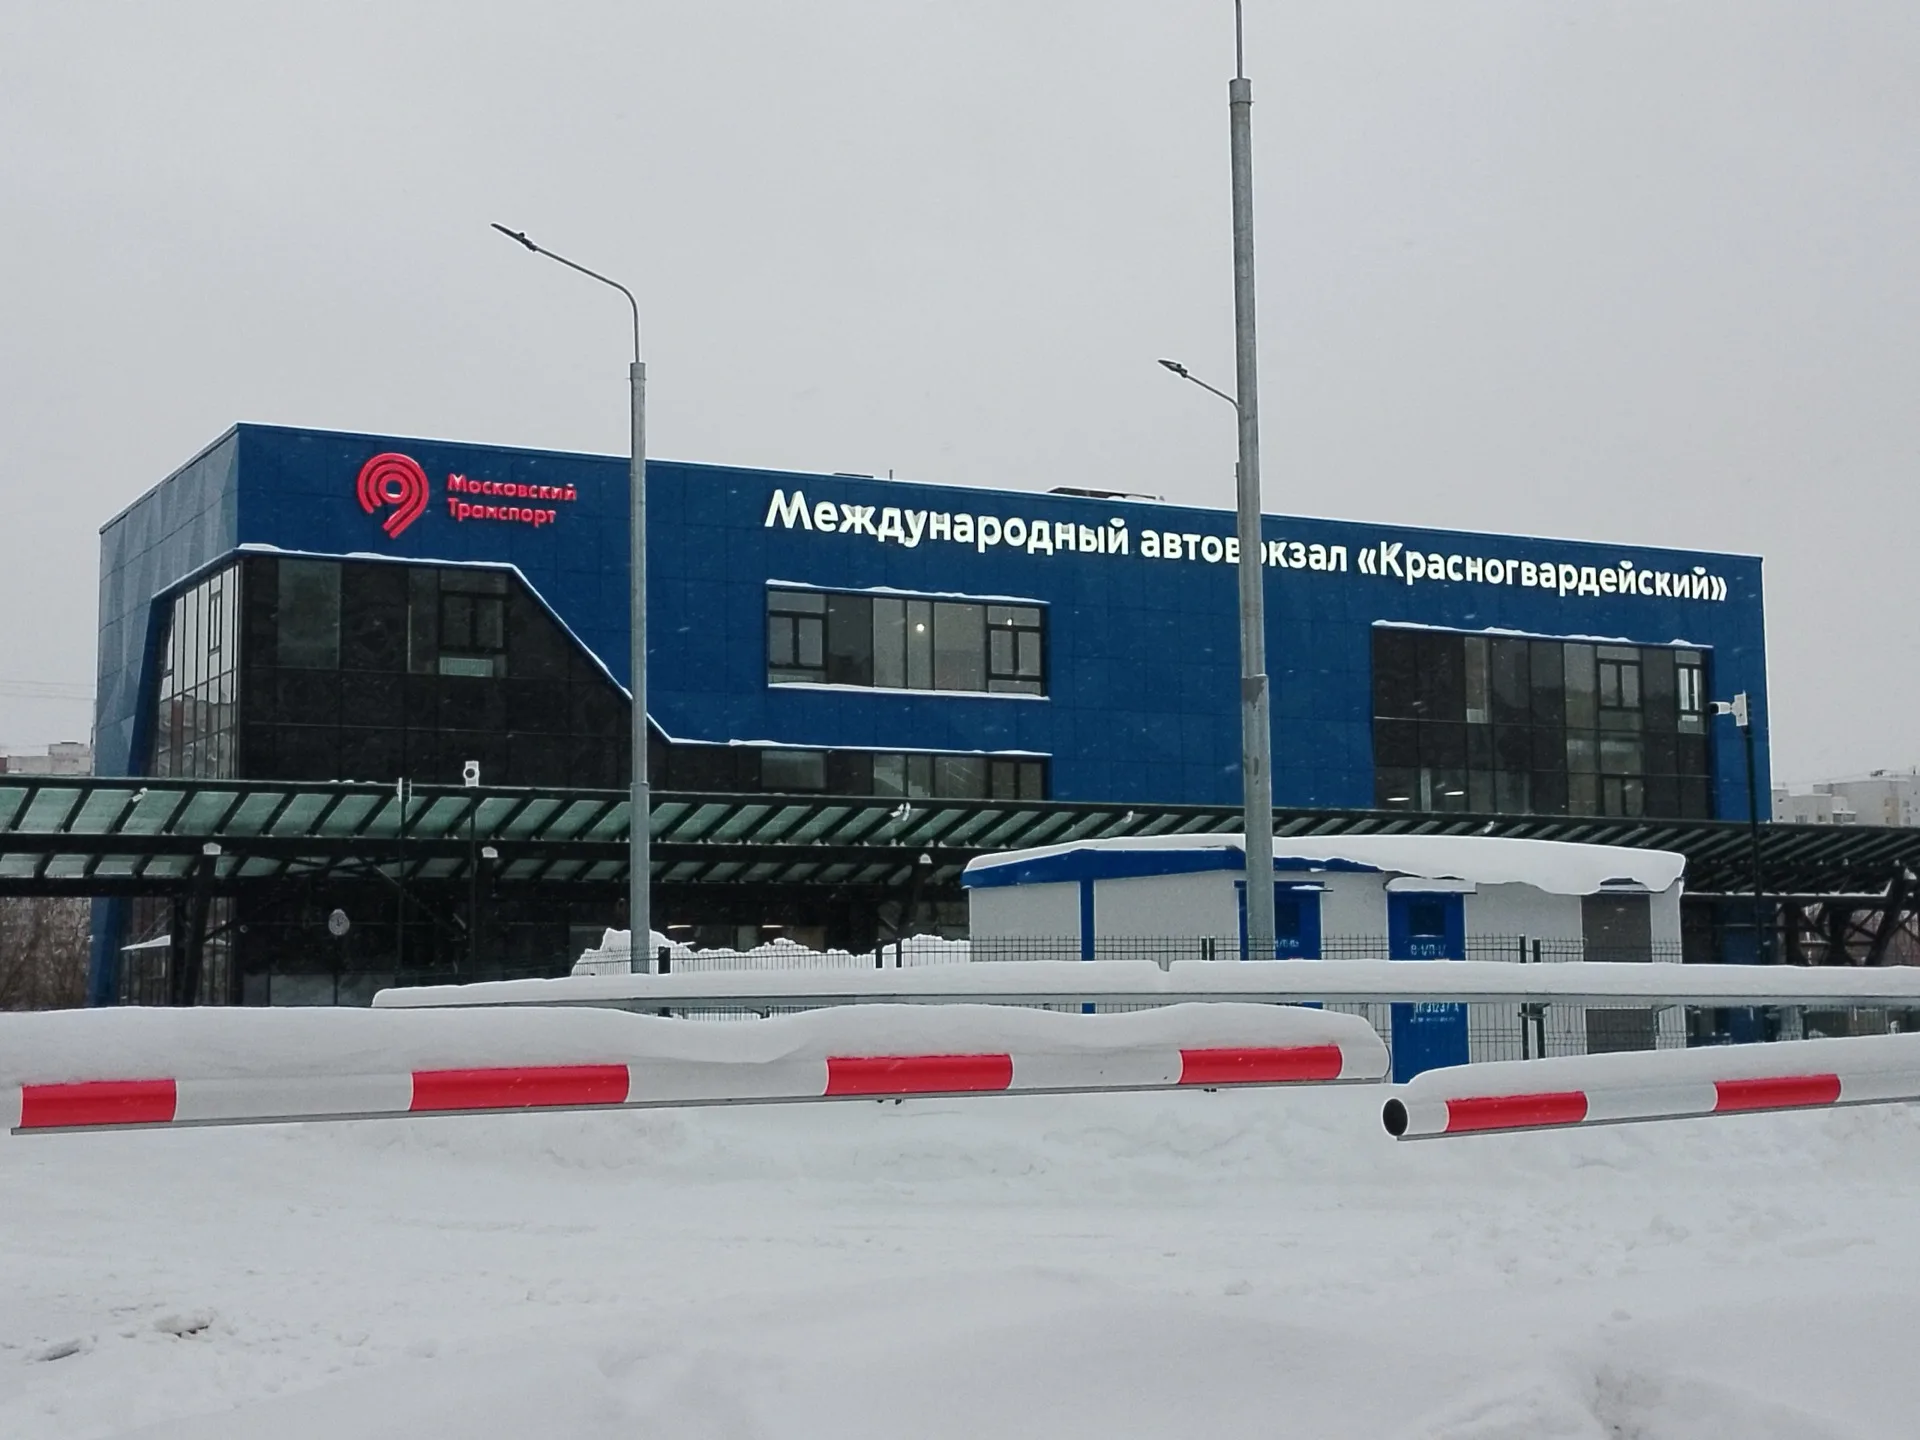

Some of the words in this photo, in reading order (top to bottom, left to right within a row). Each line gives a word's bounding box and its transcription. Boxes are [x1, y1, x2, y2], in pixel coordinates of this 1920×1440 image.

[447, 473, 577, 501] Московский
[447, 497, 557, 527] Транспорт
[764, 488, 1129, 555] Международный
[1140, 529, 1348, 572] автовкзал
[1357, 541, 1728, 602] «Красногвардейский»
